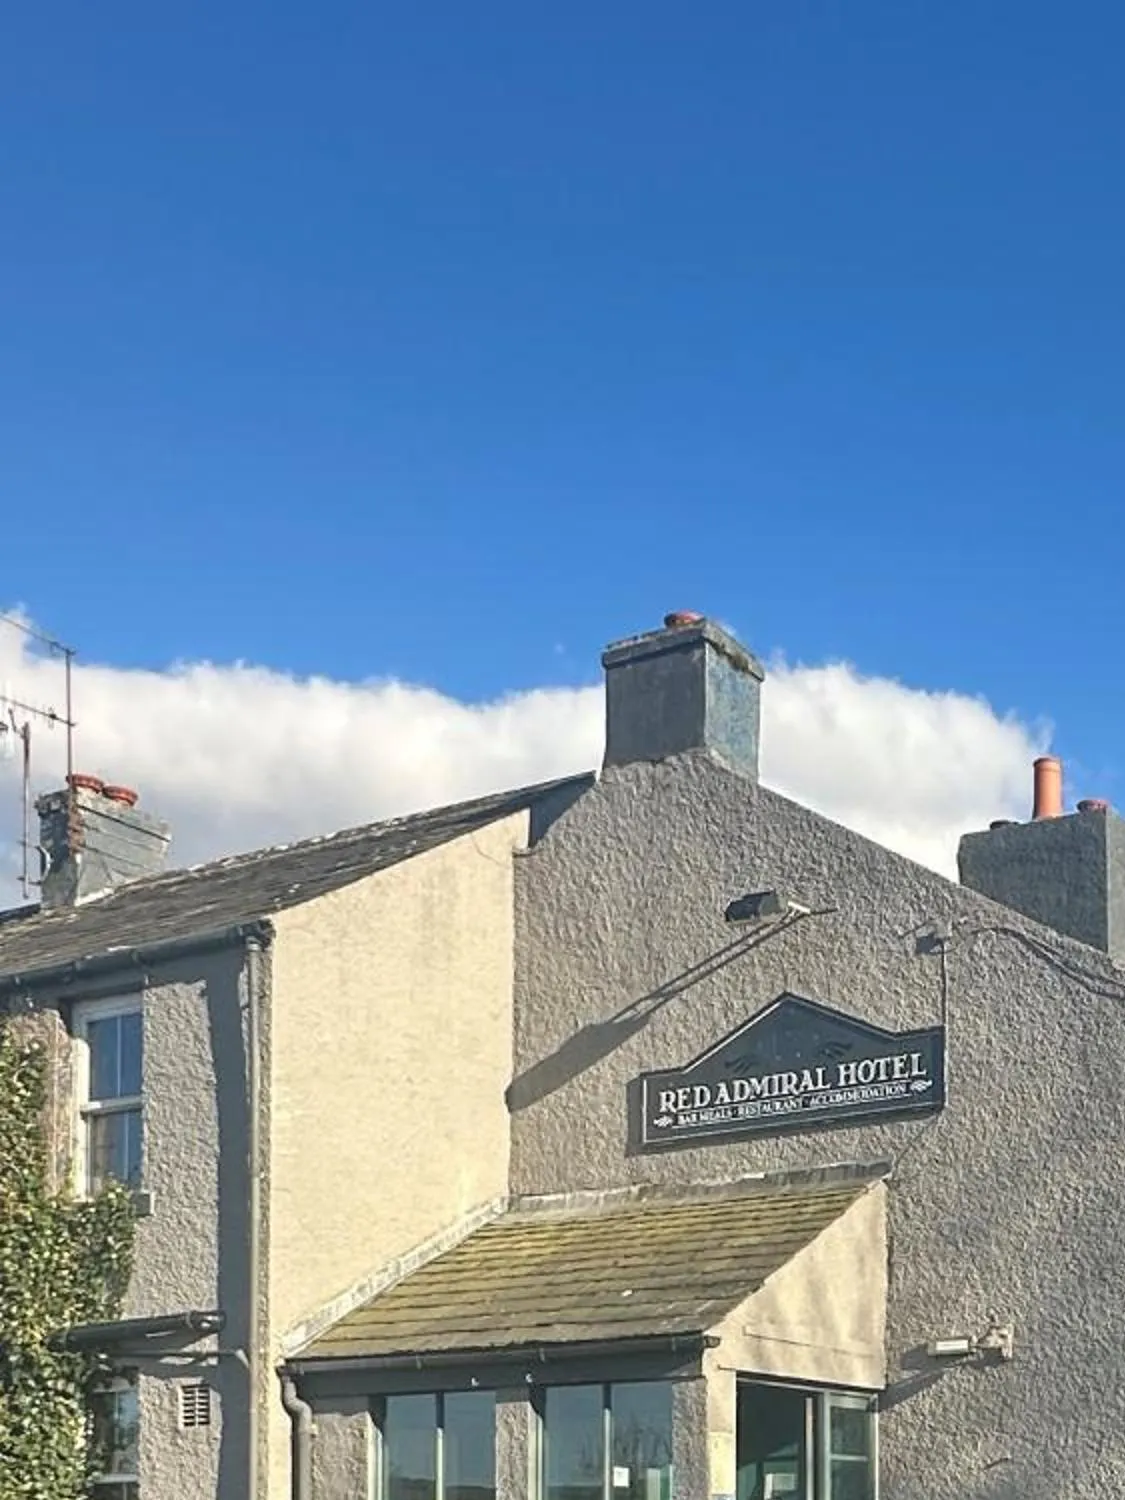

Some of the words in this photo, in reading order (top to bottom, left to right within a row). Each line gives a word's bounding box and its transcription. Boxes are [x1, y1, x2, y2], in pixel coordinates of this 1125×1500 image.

[660, 1086, 711, 1113] RED
[713, 1067, 831, 1105] ADMIRAL
[837, 1053, 927, 1086] HOTEL
